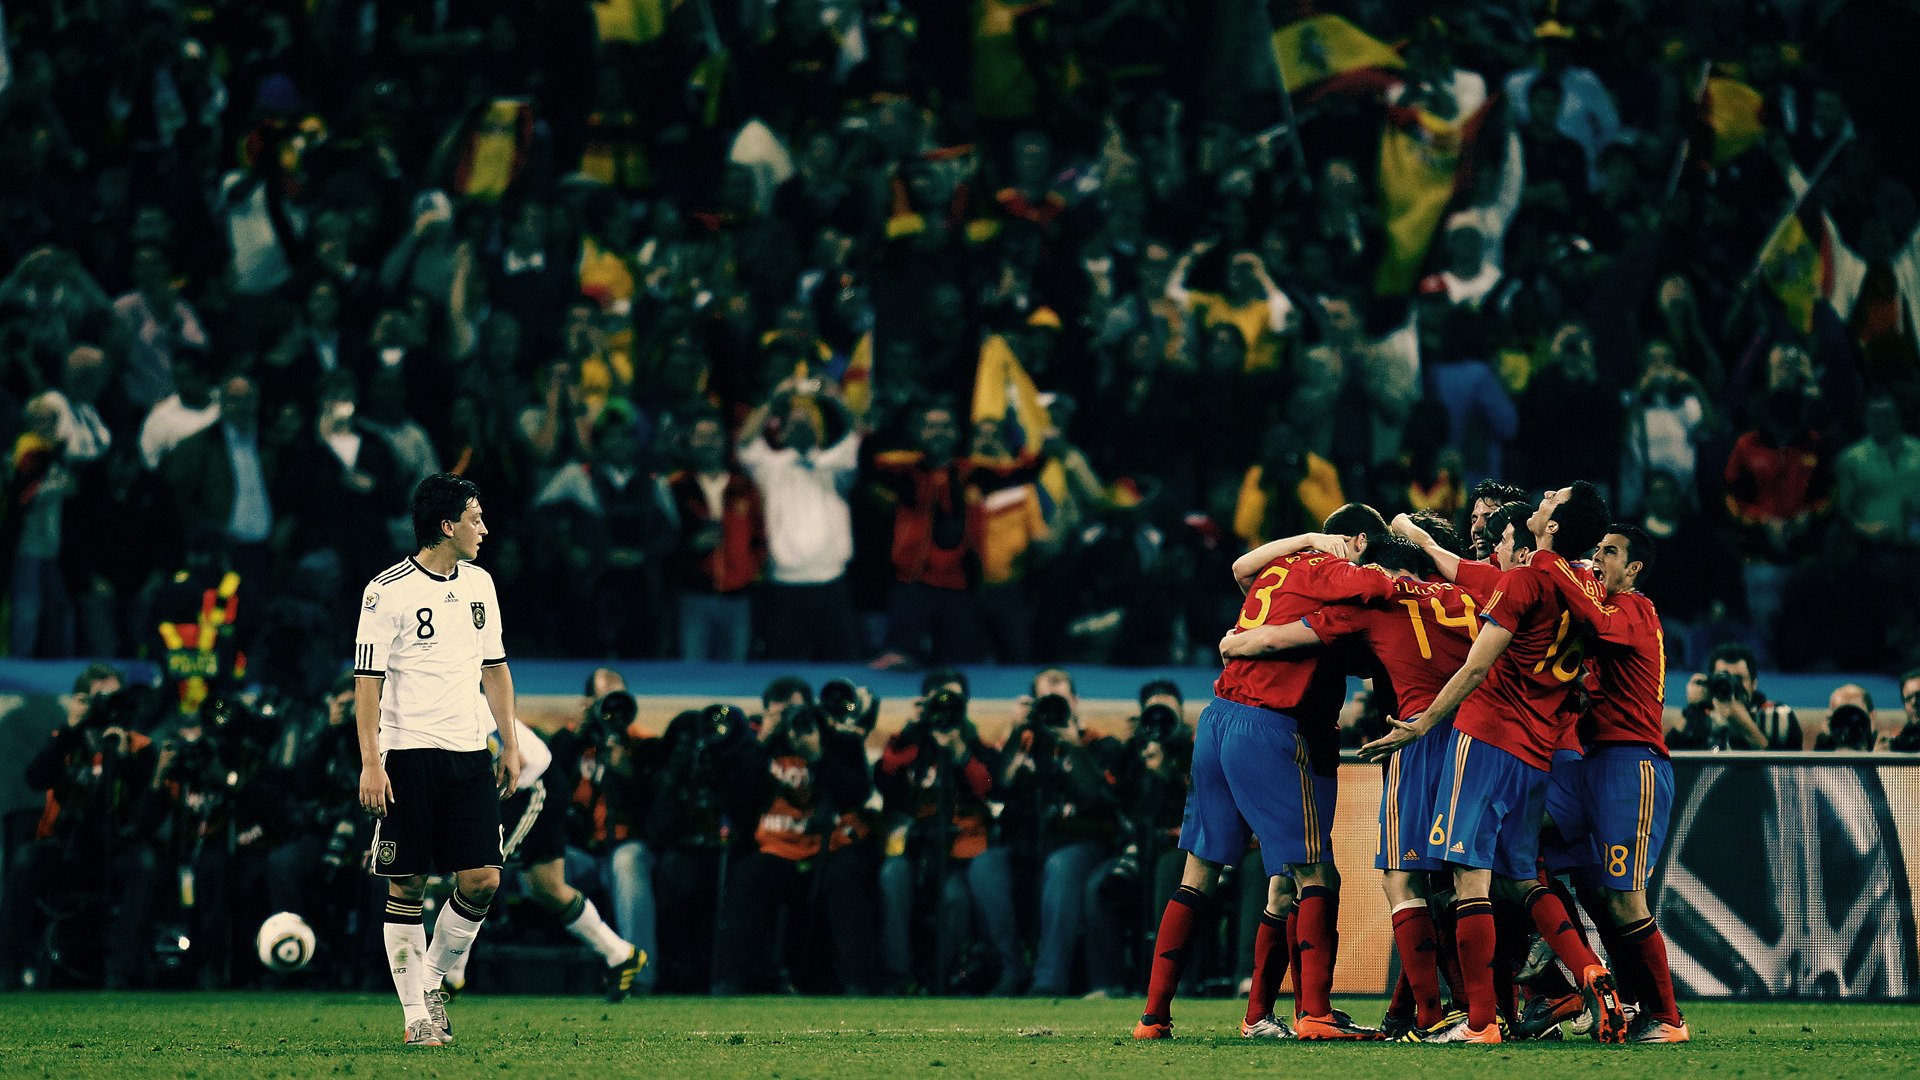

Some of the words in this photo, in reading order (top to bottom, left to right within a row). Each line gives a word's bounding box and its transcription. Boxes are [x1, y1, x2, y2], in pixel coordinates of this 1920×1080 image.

[416, 607, 435, 639] 8
[1239, 566, 1289, 630] 3
[1398, 593, 1479, 660] 14
[1533, 609, 1585, 683] 16
[1603, 842, 1629, 877] 18
